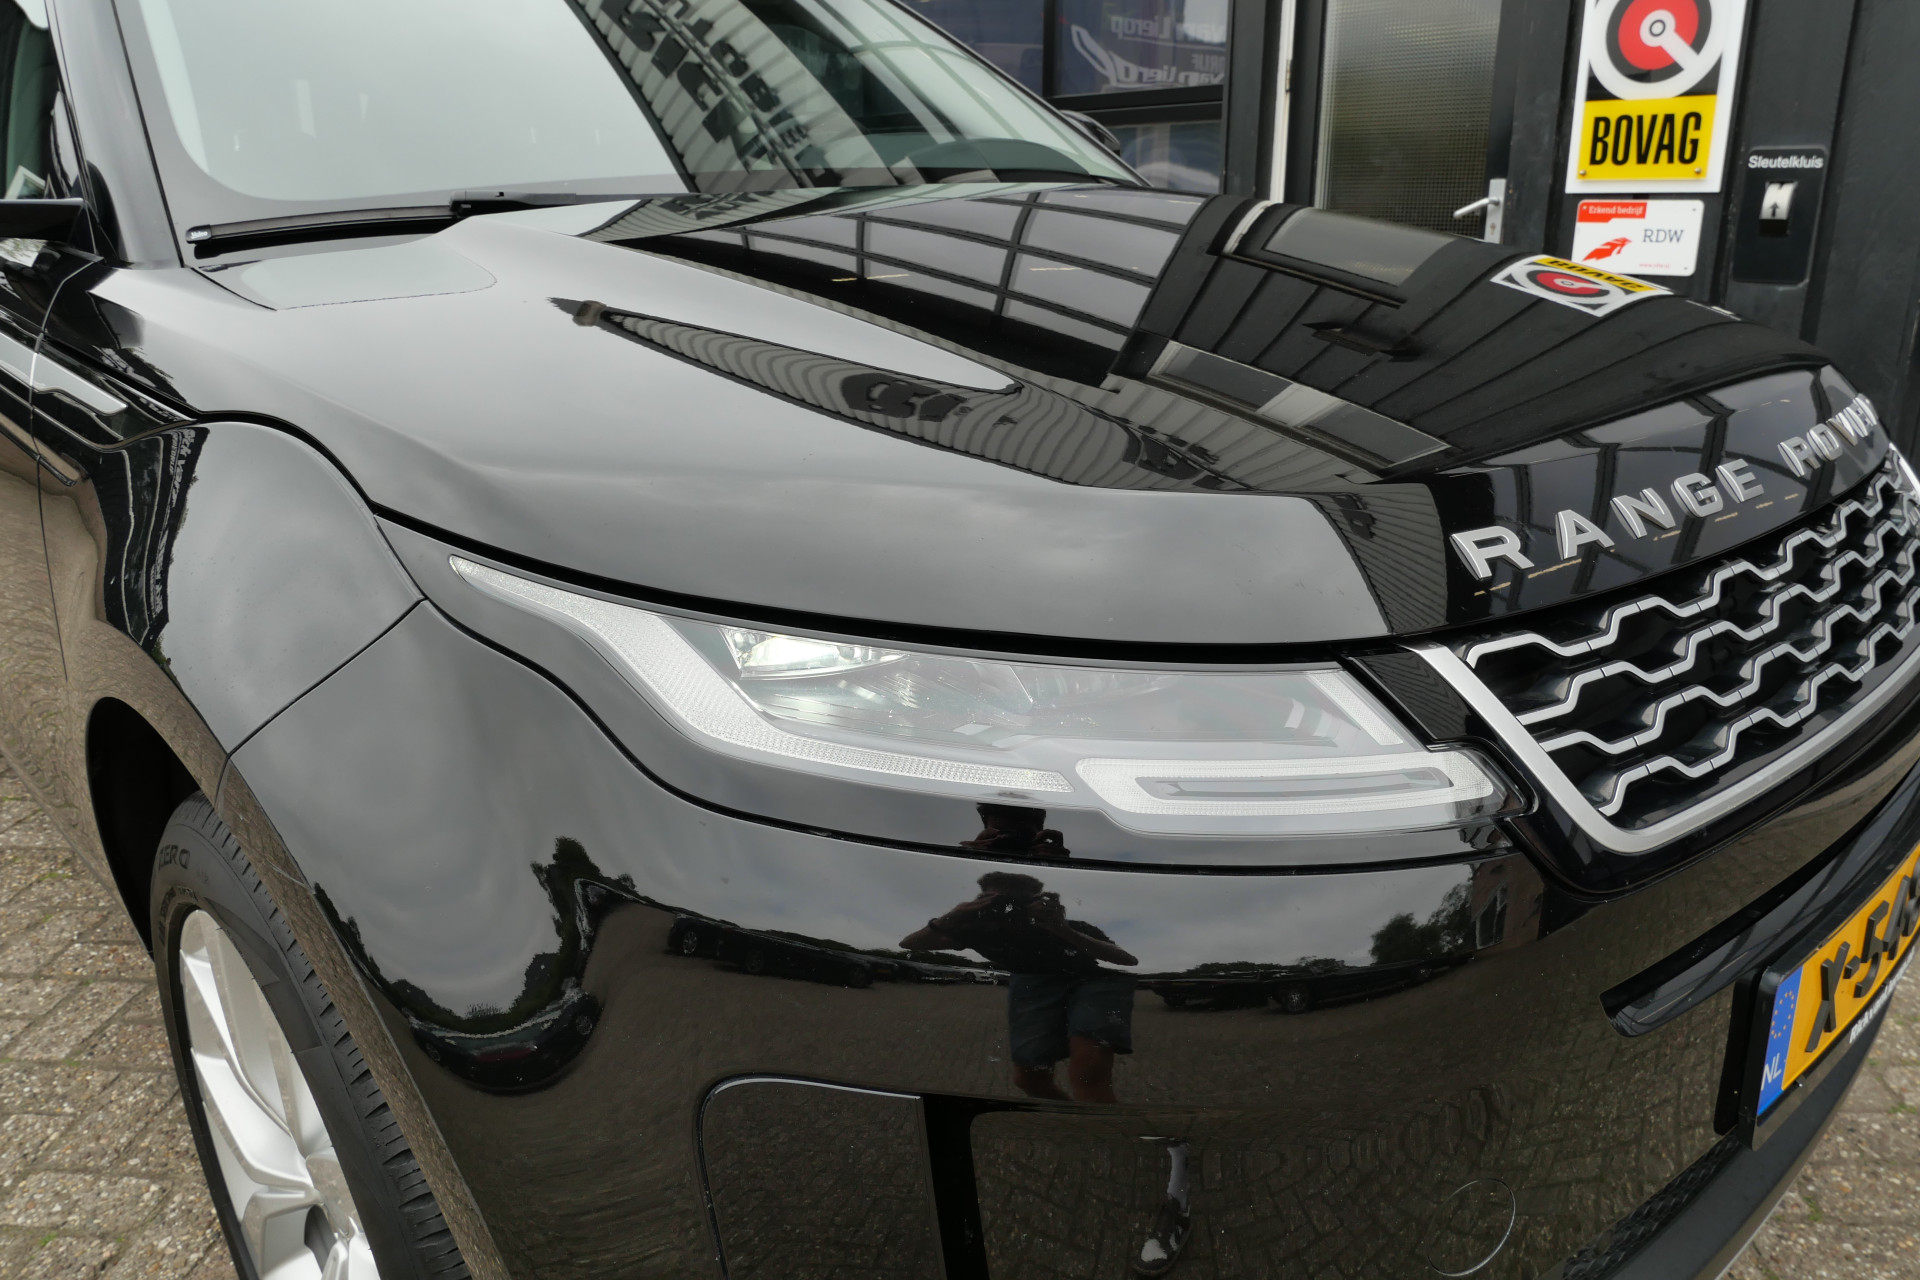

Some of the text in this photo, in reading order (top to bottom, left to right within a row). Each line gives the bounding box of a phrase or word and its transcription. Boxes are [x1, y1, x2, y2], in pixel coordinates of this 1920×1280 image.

[1589, 112, 1702, 166] BOVAG
[1748, 155, 1824, 169] Sleutelkluis
[1588, 206, 1643, 216] Erkend bedrijf
[1642, 228, 1684, 243] RDW
[1449, 458, 1764, 580] RANGE
[1760, 1052, 1782, 1091] NL
